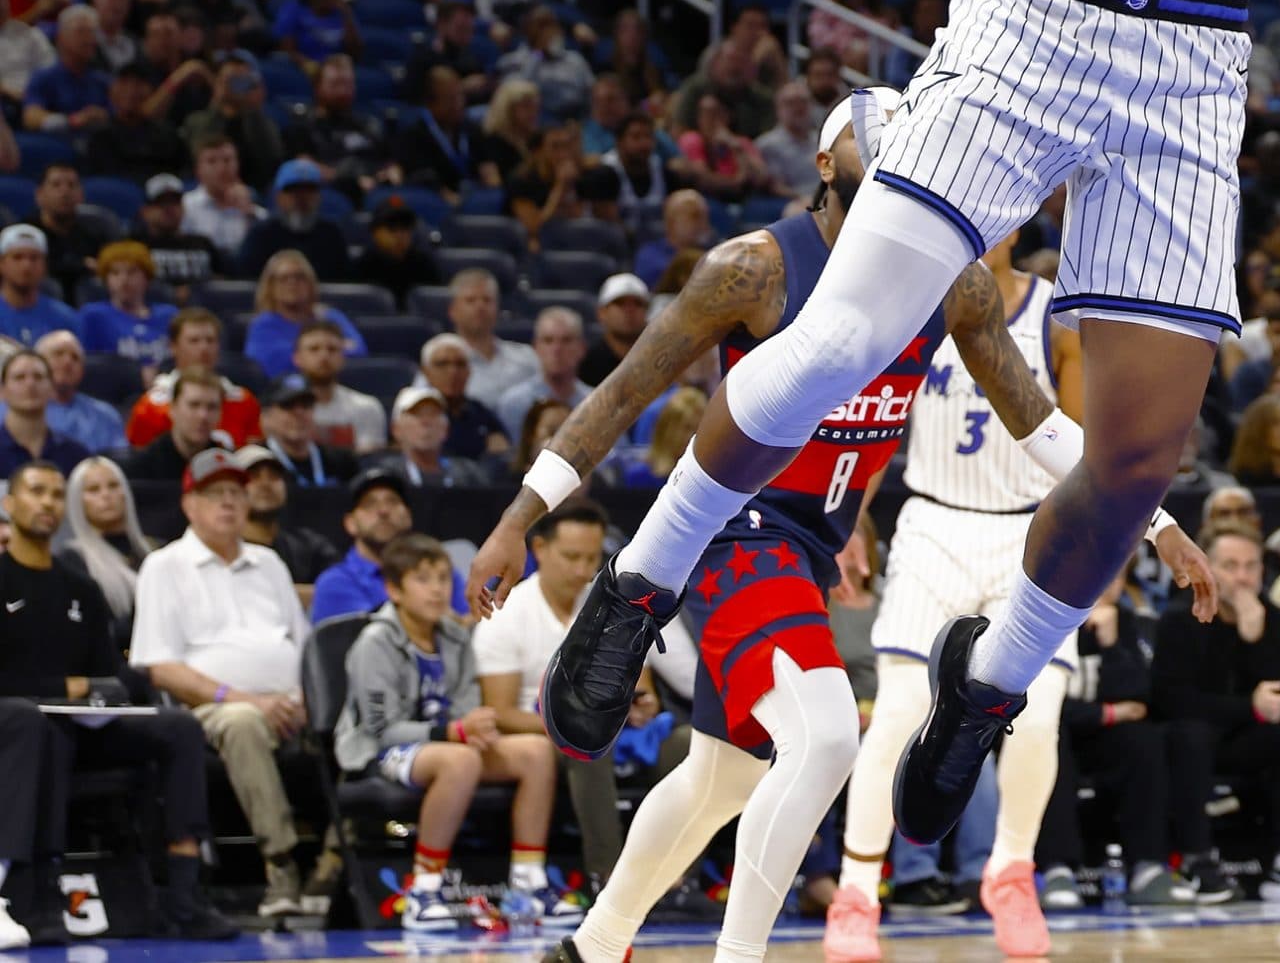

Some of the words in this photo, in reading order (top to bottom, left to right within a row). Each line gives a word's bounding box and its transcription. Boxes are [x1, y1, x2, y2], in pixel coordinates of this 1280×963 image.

[824, 384, 914, 423] strict
[818, 427, 904, 440] COLUMBIA
[955, 409, 992, 456] 3
[824, 451, 860, 515] 8
